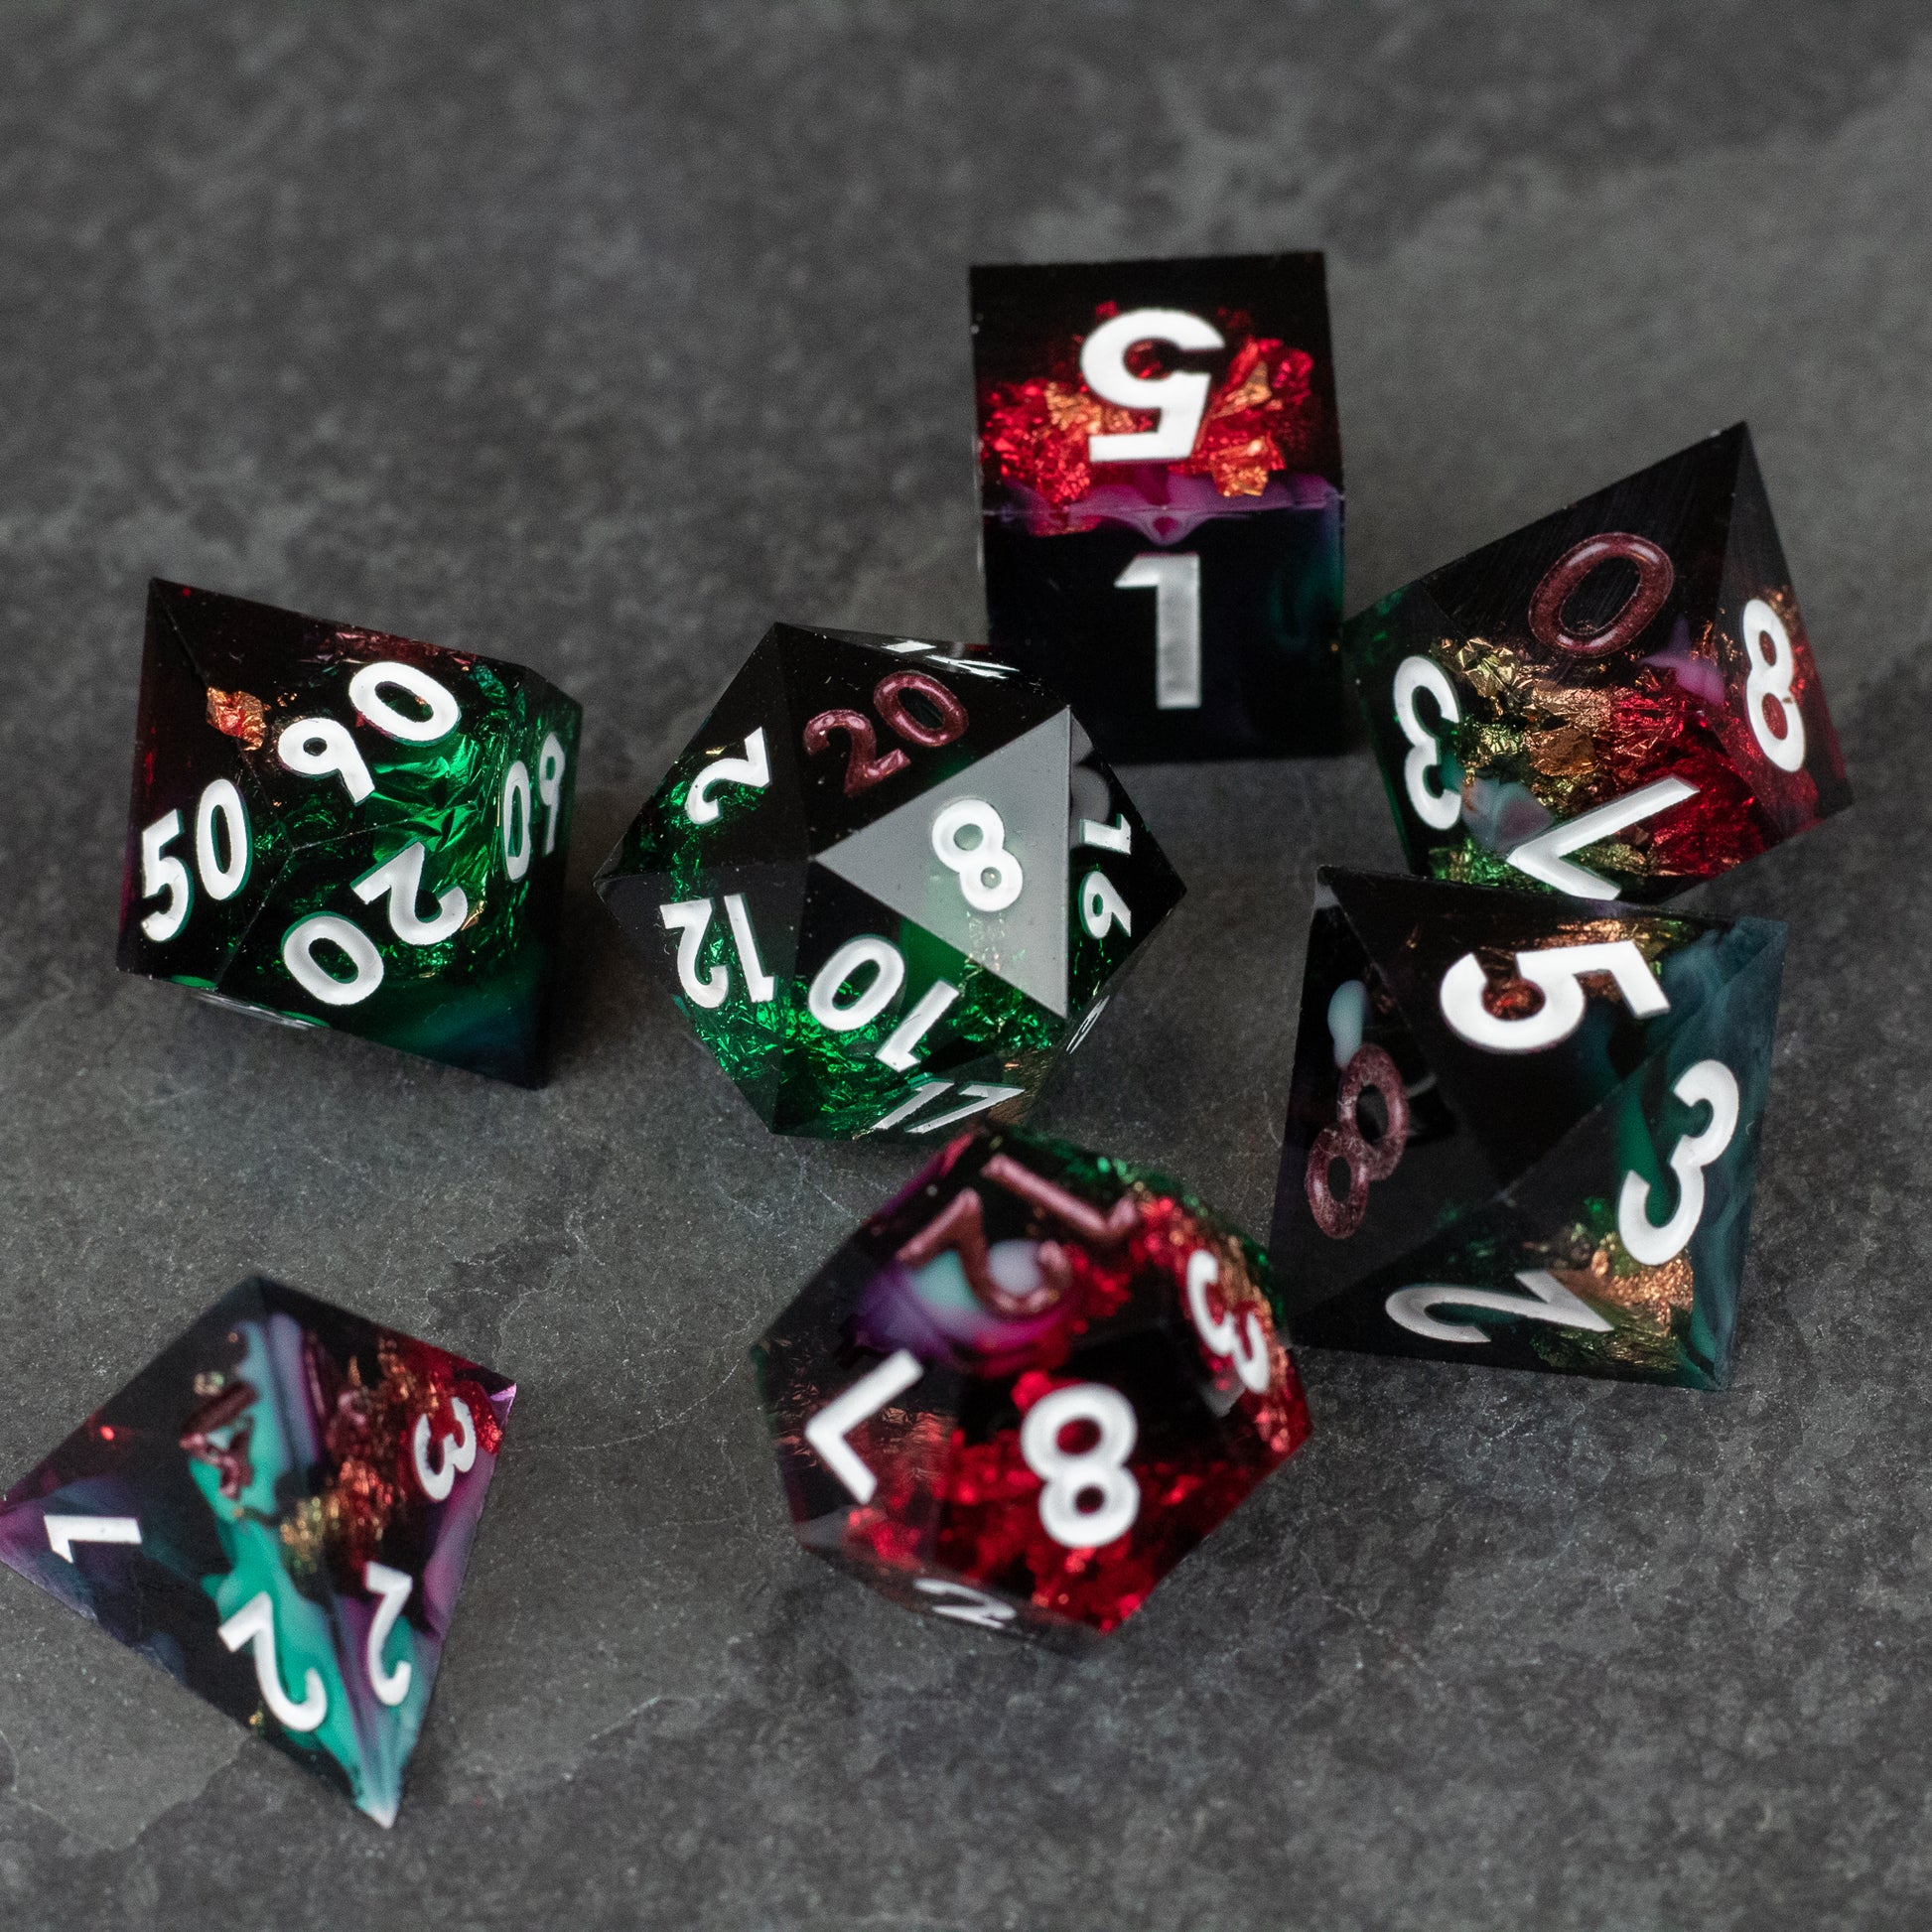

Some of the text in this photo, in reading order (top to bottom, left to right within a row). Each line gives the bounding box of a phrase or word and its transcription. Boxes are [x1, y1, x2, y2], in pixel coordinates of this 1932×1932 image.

[1079, 308, 1225, 463] 5
[1114, 552, 1201, 709] 1
[1528, 532, 1675, 658] 0
[277, 661, 462, 806] 90
[803, 670, 969, 794] 20
[1393, 655, 1462, 830] 3
[1741, 598, 1806, 773] 8
[684, 726, 772, 826] 2
[1505, 776, 1701, 901] 7
[141, 778, 251, 942] 50
[282, 842, 470, 1006] 20
[931, 798, 1024, 912] 8
[659, 894, 777, 1009] 12
[807, 937, 960, 1073] 10
[1439, 938, 1671, 1054] 5
[1618, 1058, 1739, 1266] 3
[1186, 1249, 1272, 1394] 3
[1384, 1270, 1614, 1344] 2
[413, 1396, 478, 1501] 3
[1021, 1383, 1141, 1550] 8
[43, 1514, 143, 1565] 1
[217, 1590, 328, 1731] 2
[365, 1561, 413, 1707] 2
